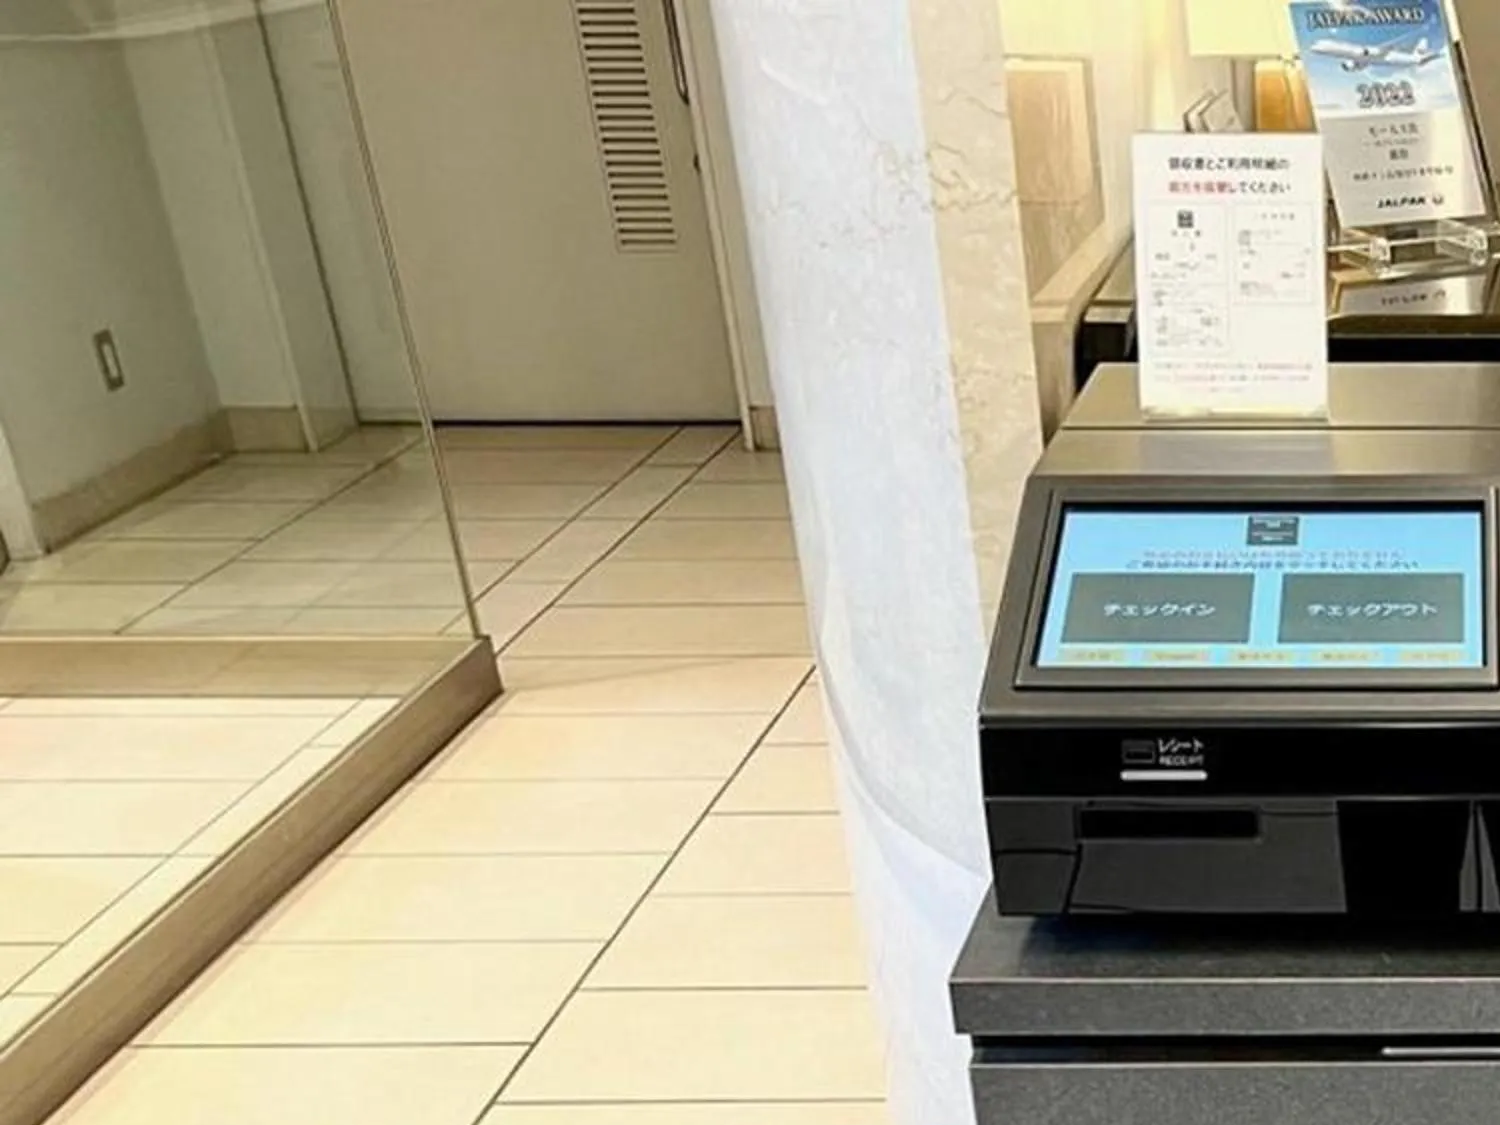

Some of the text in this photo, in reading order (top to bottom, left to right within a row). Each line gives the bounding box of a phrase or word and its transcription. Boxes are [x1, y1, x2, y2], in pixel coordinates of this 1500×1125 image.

[1103, 603, 1216, 617] チェックイン
[1306, 603, 1439, 617] チェックアウト
[1157, 737, 1204, 753] レシート
